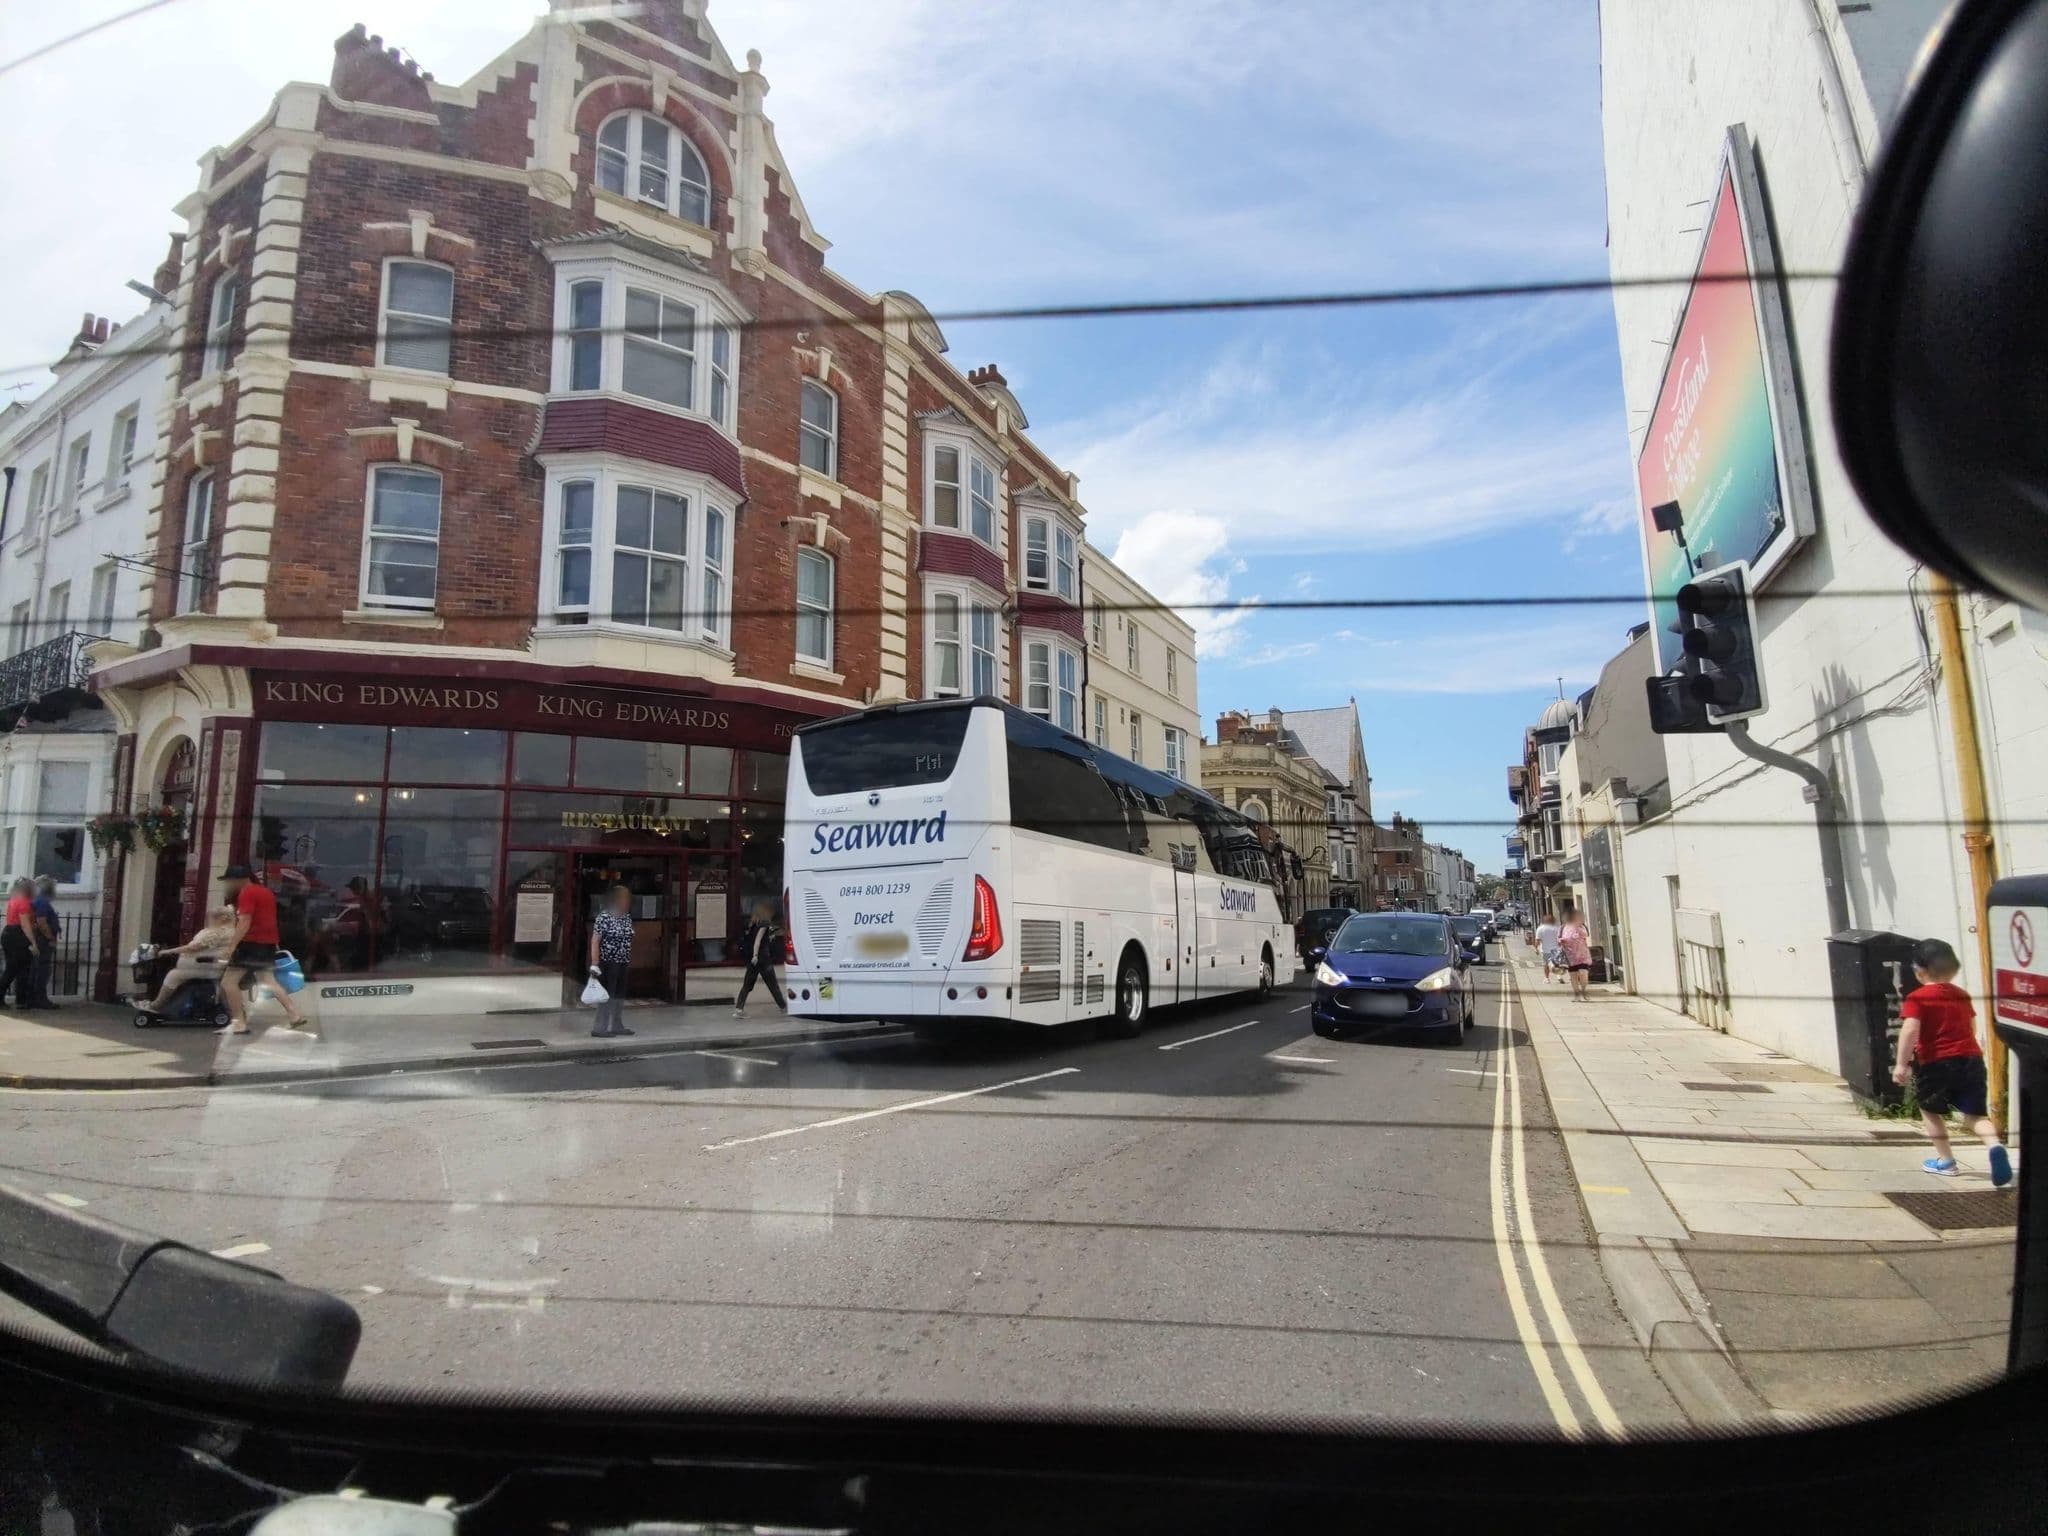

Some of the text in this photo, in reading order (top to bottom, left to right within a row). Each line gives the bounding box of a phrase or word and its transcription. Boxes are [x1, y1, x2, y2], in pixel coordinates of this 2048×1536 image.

[265, 680, 500, 710] KING EDWARDS
[537, 694, 730, 729] KING EDWARDS
[774, 723, 793, 737] FIS
[561, 811, 696, 832] RESTAURANT
[810, 809, 947, 855] Seaward
[840, 883, 911, 897] 0844 800 1239
[1220, 881, 1256, 912] Seaward
[854, 910, 894, 925] Dorset
[335, 987, 364, 997] KING
[2013, 976, 2028, 994] Not
